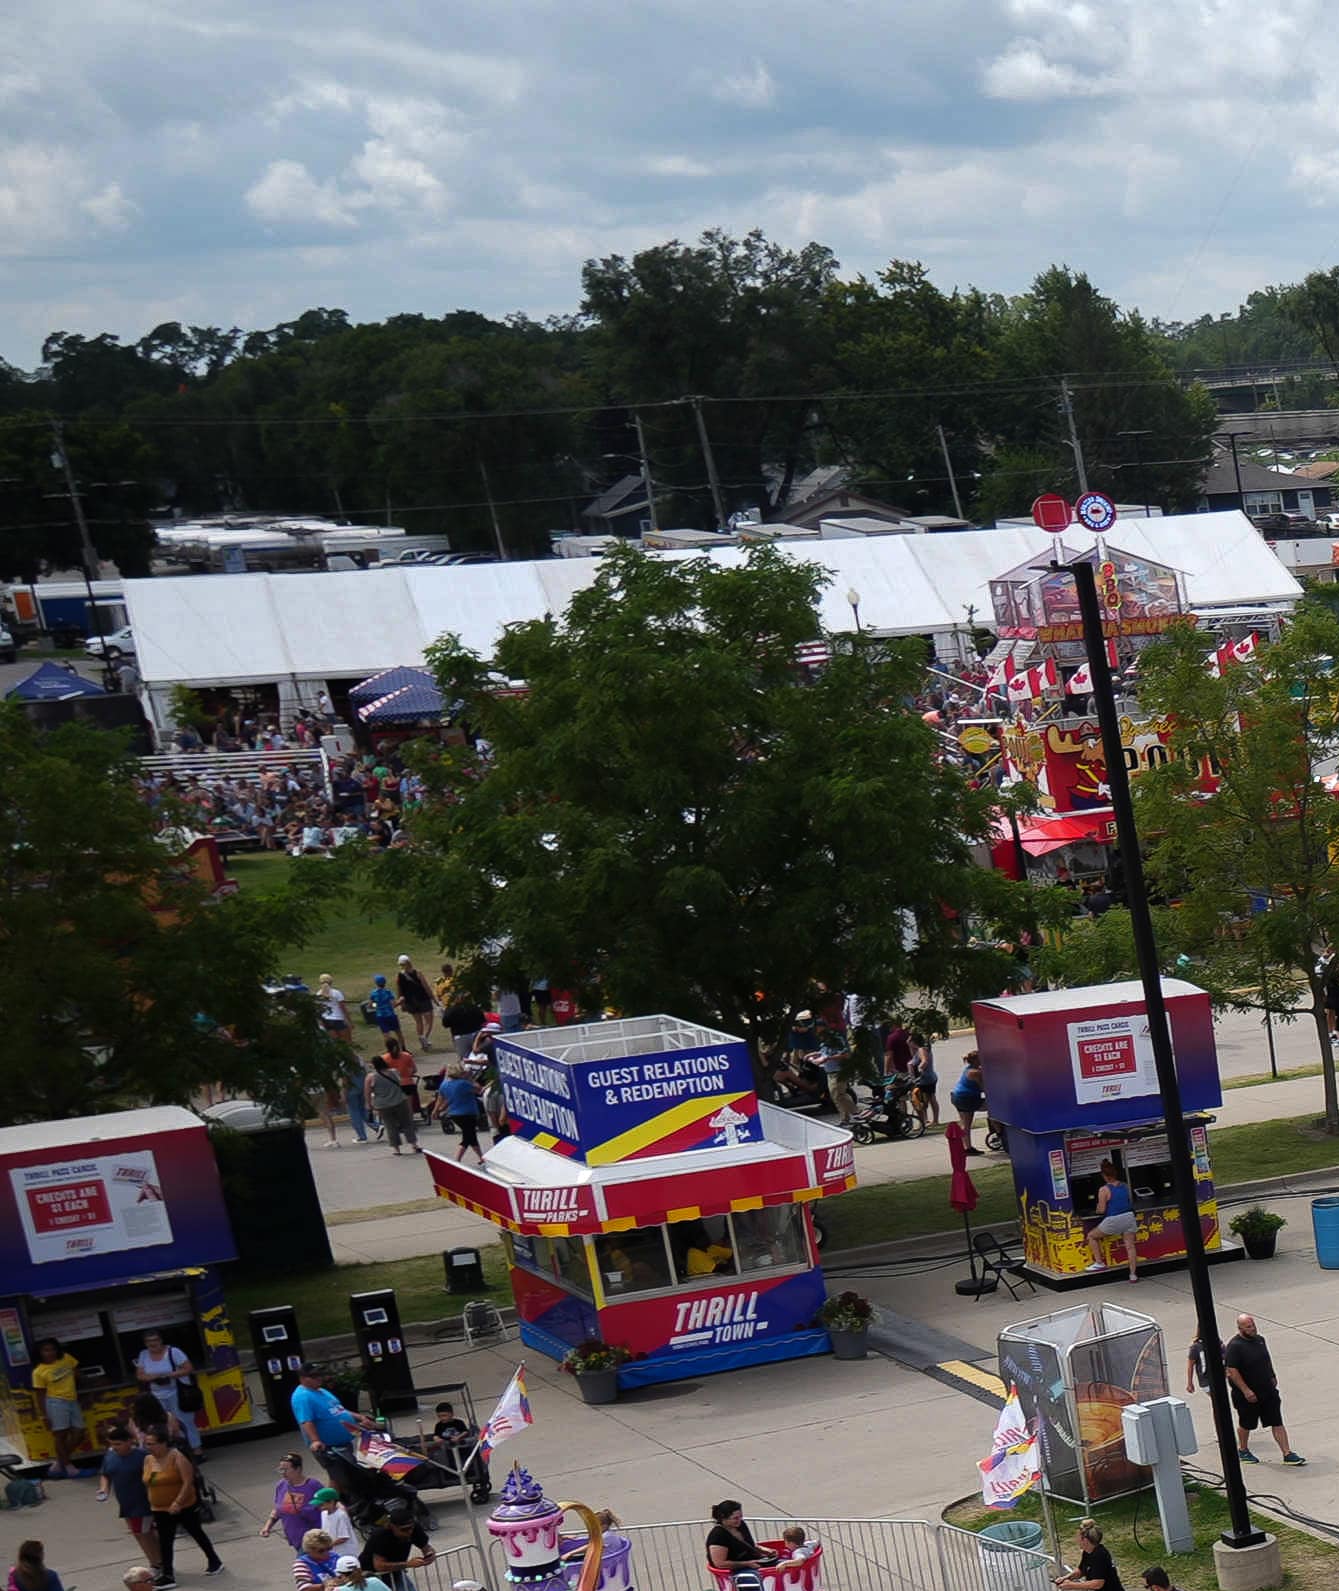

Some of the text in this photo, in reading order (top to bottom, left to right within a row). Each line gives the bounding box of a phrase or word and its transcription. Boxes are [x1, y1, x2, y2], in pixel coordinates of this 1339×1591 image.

[1103, 563, 1119, 608] BBQ
[1084, 1040, 1129, 1053] CREDITS ARE
[1103, 1051, 1121, 1061] EACH
[496, 1046, 571, 1101] GUEST RELATIONS
[588, 1054, 730, 1089] GUEST RELATIONS
[605, 1074, 726, 1106] & REDEMPTION
[504, 1082, 581, 1142] & REDEMPTION
[35, 1185, 99, 1205] CREDITS ARE
[64, 1198, 90, 1212] EACH
[523, 1188, 579, 1212] THRILL
[545, 1209, 580, 1224] PARKS
[674, 1290, 759, 1333] THRILL
[714, 1321, 755, 1344] TOWN
